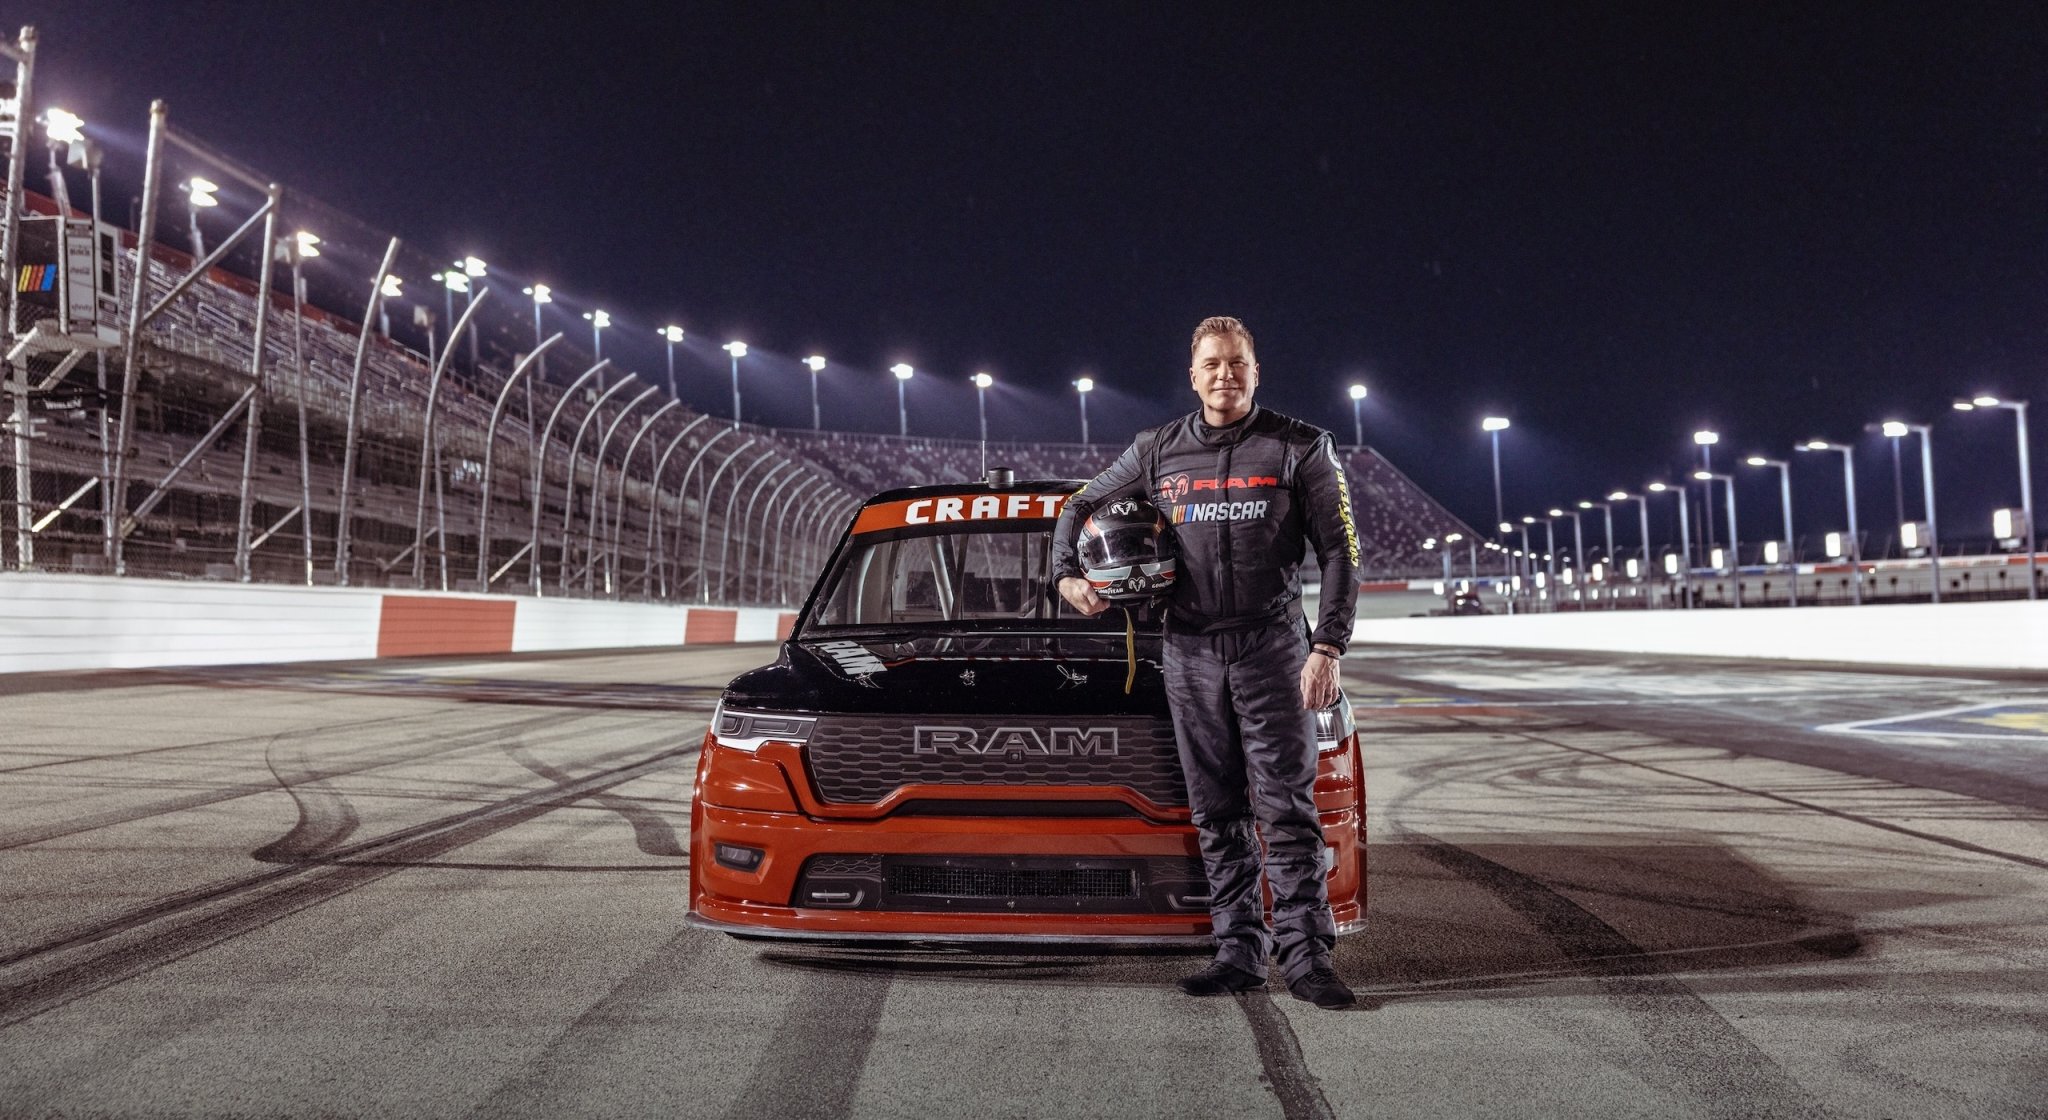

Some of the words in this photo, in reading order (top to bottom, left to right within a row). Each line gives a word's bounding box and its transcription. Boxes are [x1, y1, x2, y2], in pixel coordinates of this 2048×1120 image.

[1193, 477, 1277, 491] RAM
[905, 496, 1064, 525] CRAFT
[1192, 501, 1267, 522] NASCAR
[814, 641, 888, 675] RAM
[914, 726, 1118, 755] RAM
